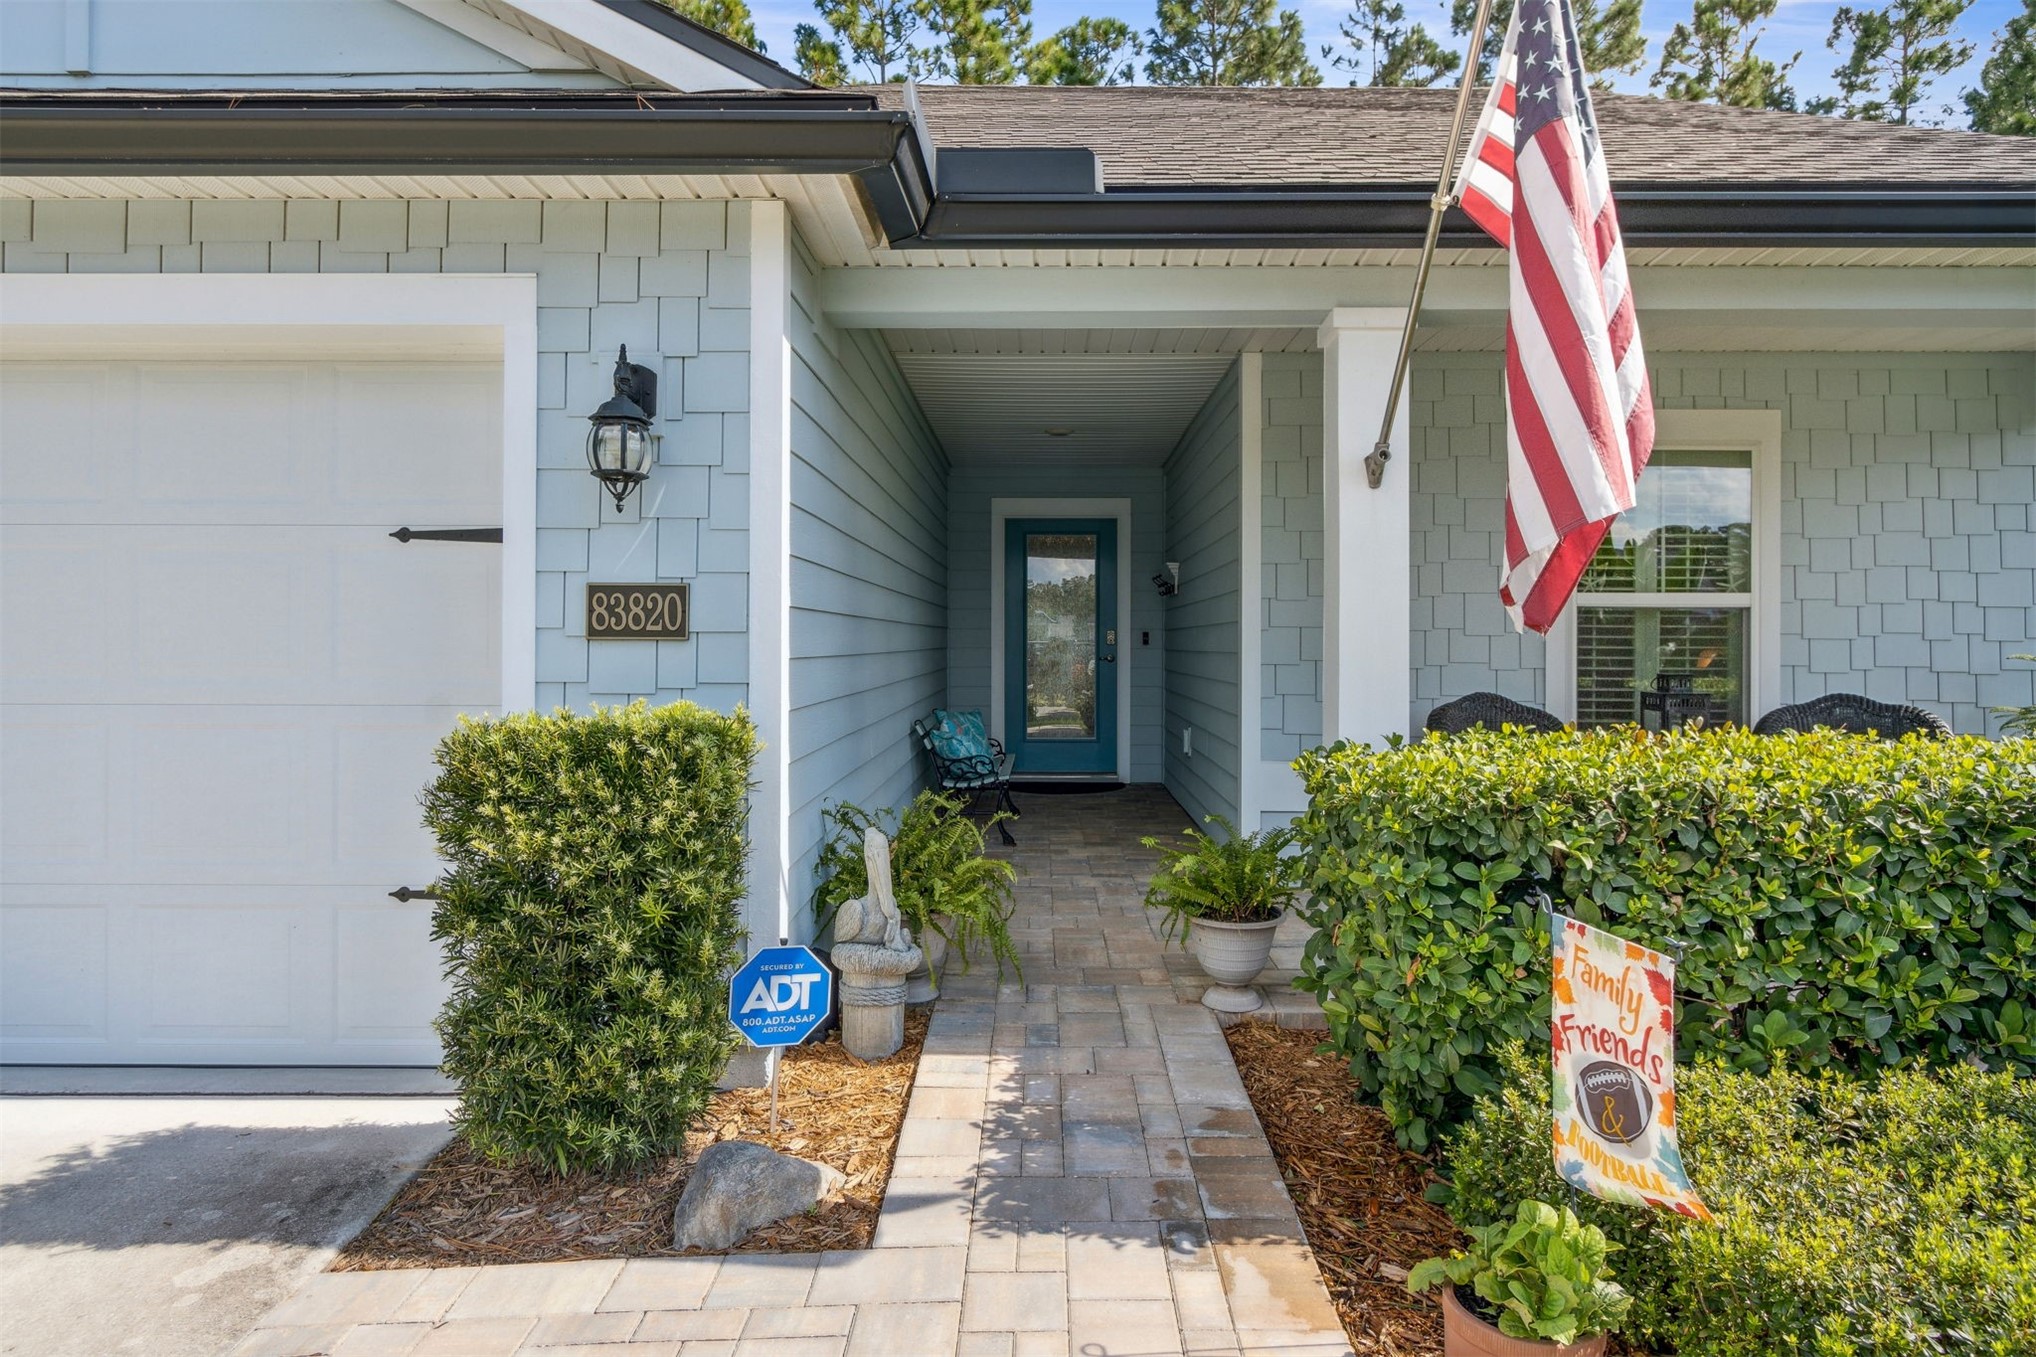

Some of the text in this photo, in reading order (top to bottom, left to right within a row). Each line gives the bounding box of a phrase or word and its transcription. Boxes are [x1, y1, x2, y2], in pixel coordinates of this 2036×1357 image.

[591, 592, 682, 631] 83820
[740, 973, 821, 1014] ADT
[1571, 943, 1643, 1035] Family
[742, 1014, 816, 1026] 800.ADT.ASAP
[761, 1025, 796, 1034] ADT.COM
[1559, 1013, 1663, 1085] Friends
[1602, 1095, 1632, 1148] &
